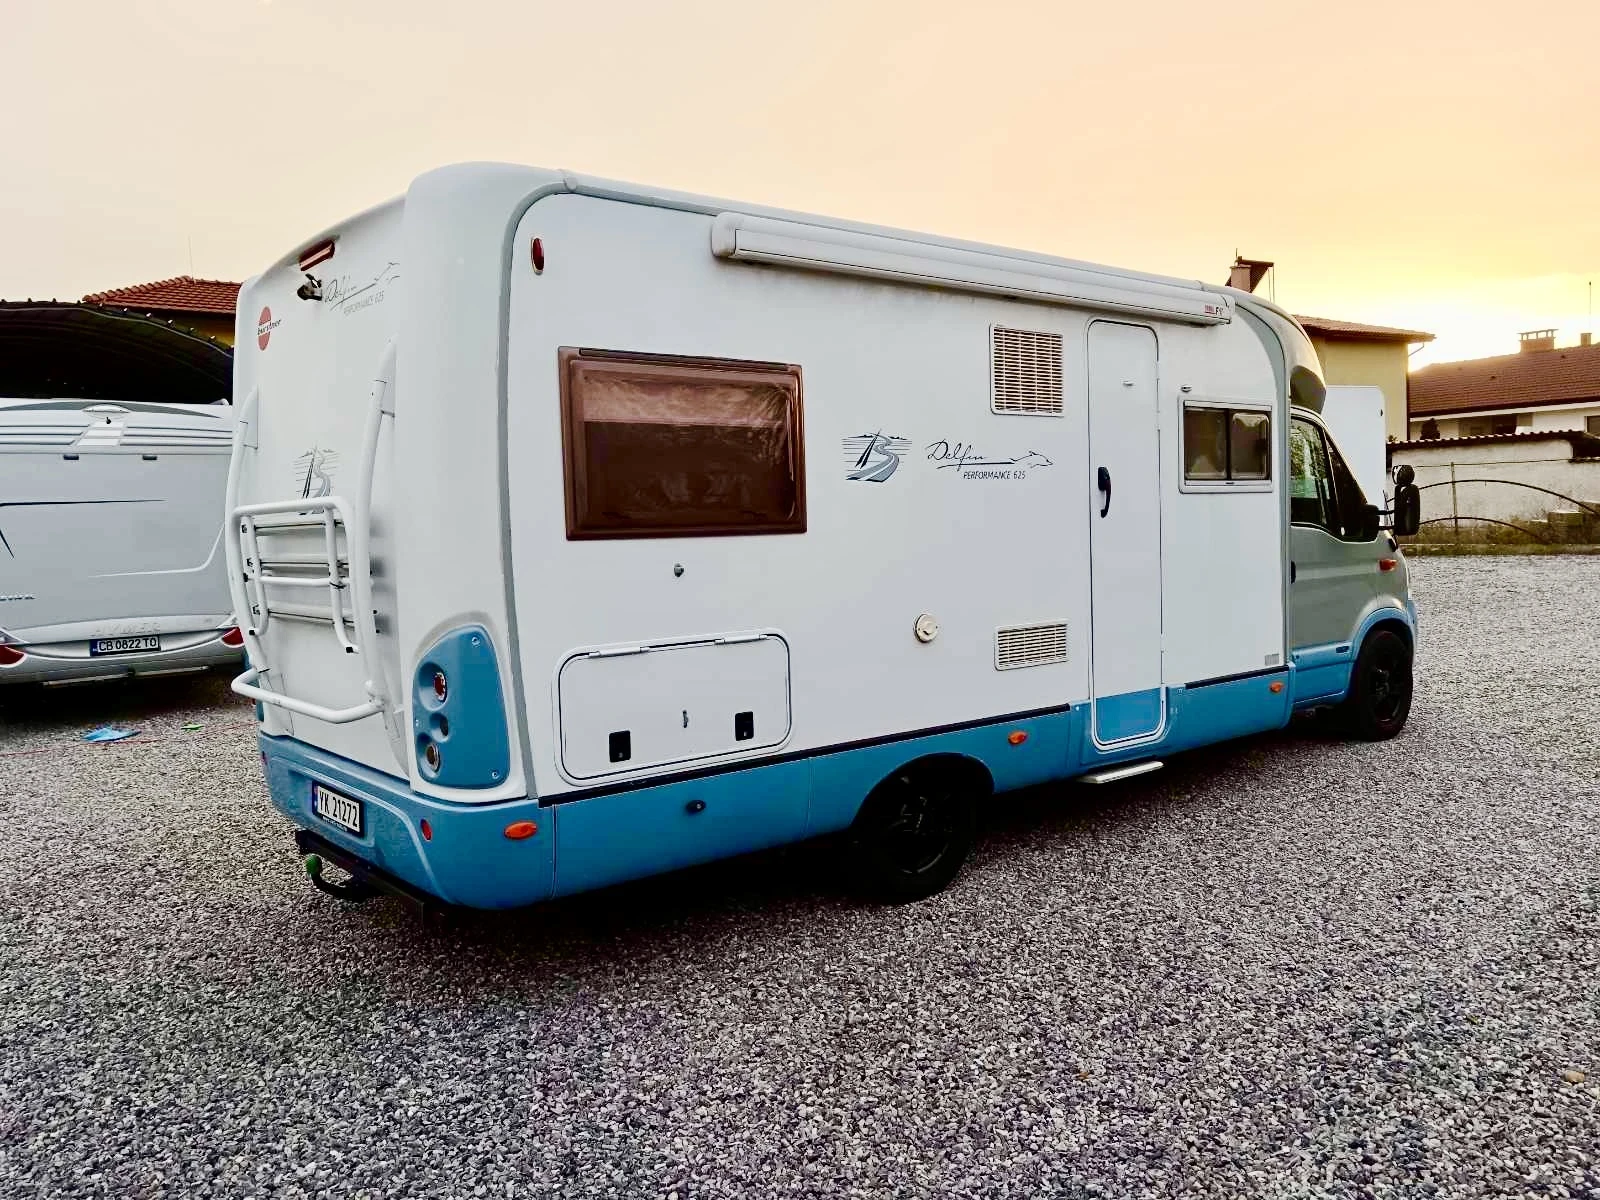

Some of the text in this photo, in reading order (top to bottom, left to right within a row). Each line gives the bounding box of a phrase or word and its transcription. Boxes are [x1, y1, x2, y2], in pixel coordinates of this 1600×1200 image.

[926, 438, 984, 472] Delfin
[963, 470, 1026, 480] PERFORMANCE 625
[99, 637, 157, 652] CB 0822 TO
[319, 790, 330, 815] YK
[332, 796, 358, 827] 21272
